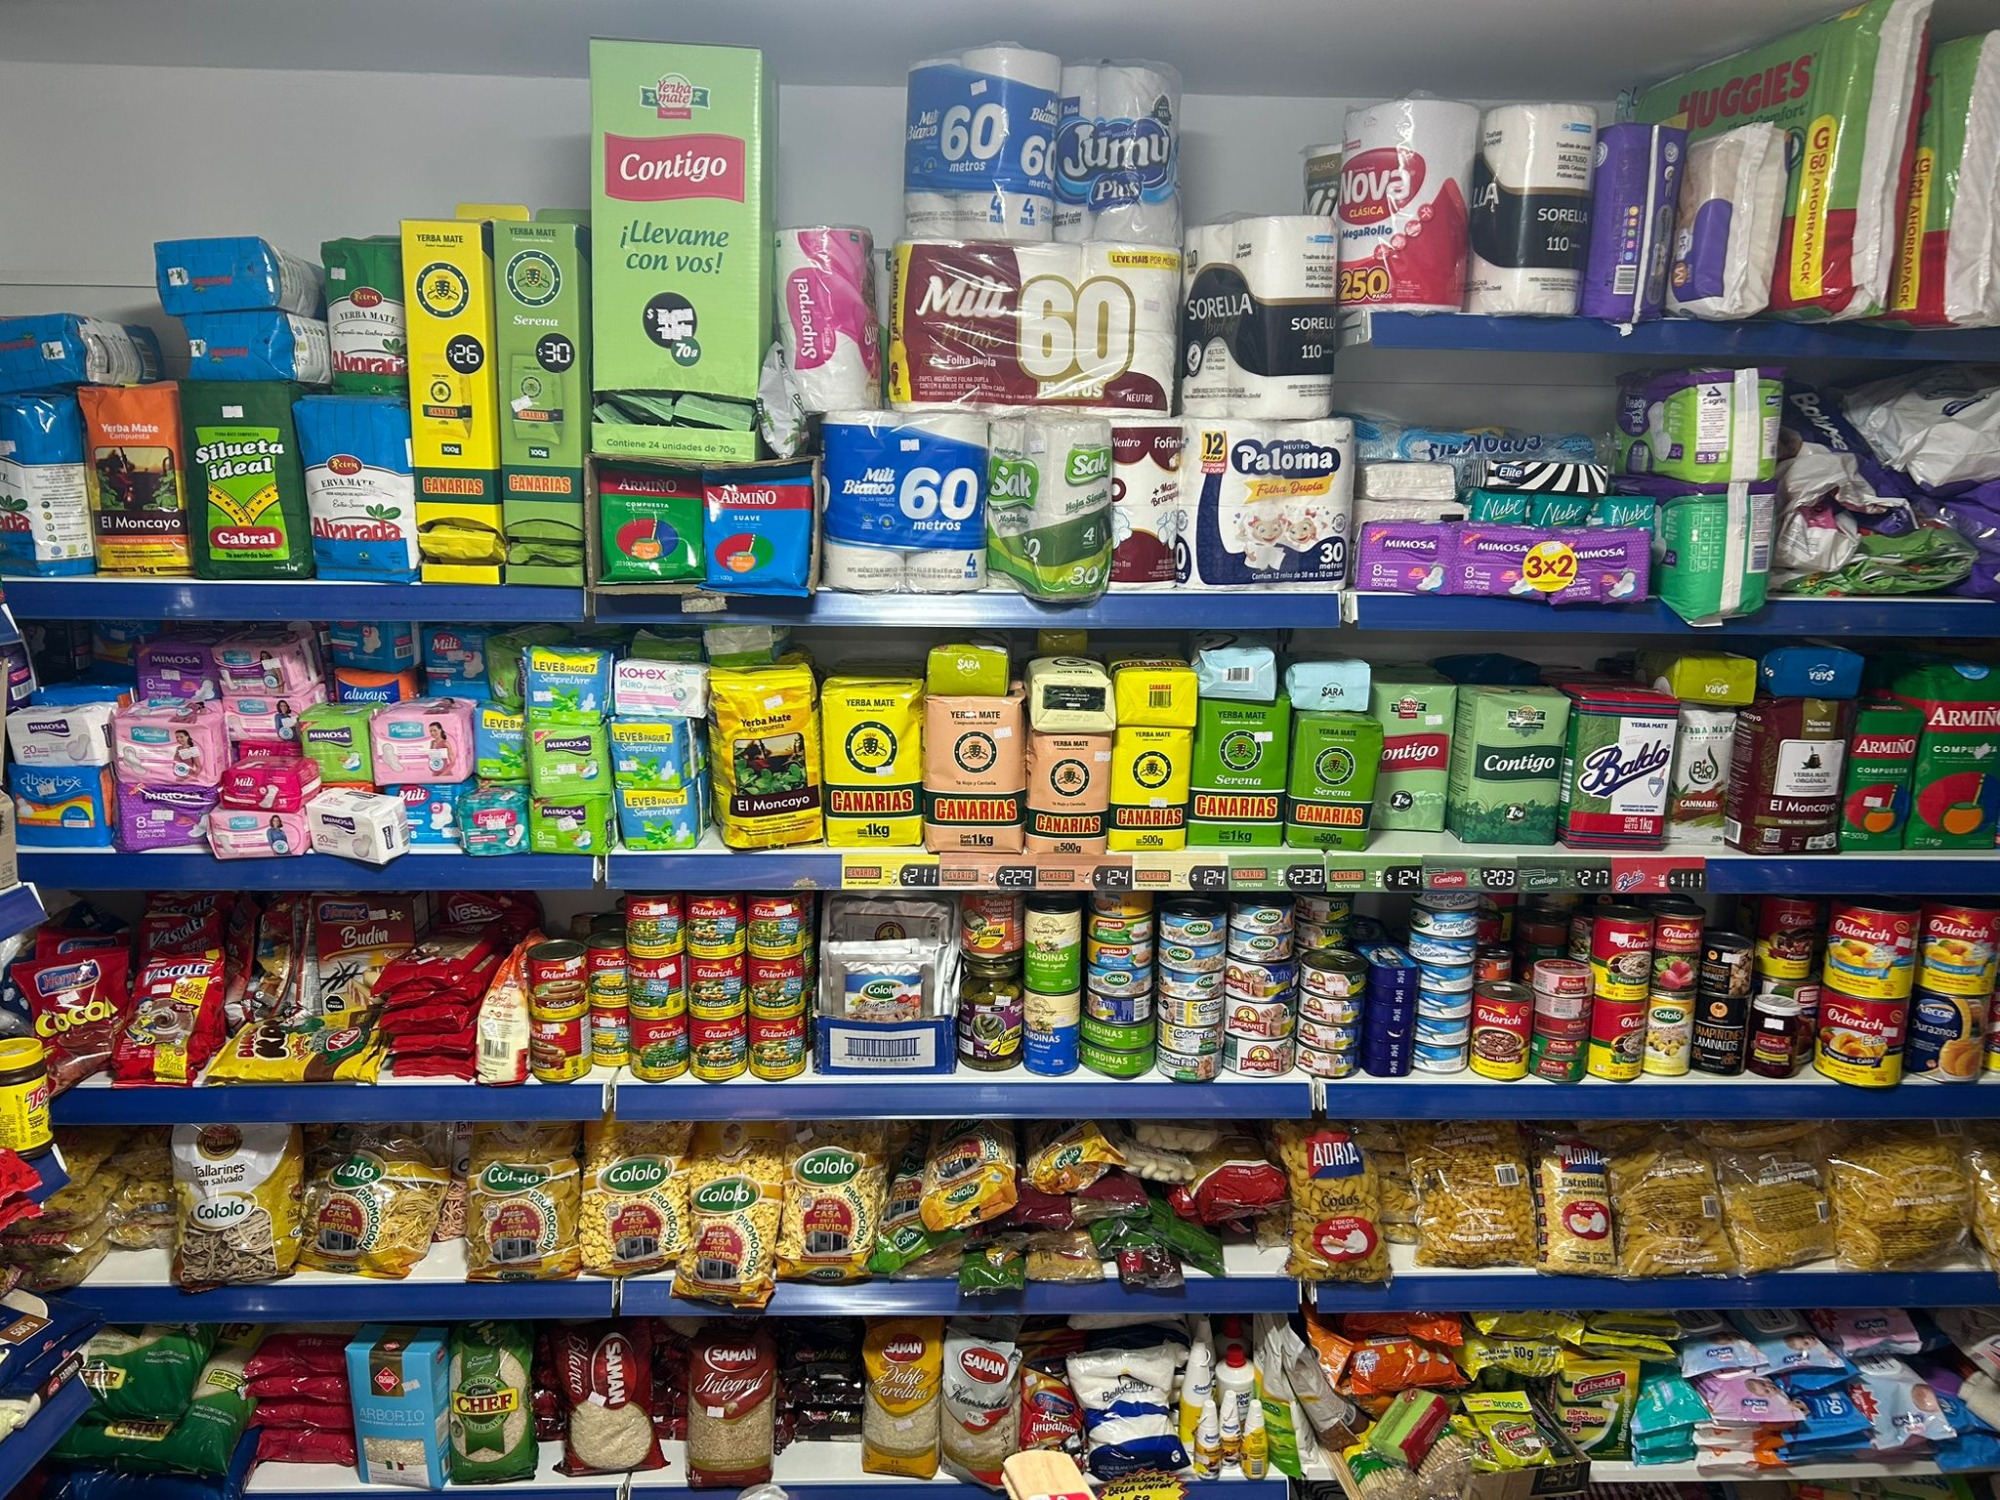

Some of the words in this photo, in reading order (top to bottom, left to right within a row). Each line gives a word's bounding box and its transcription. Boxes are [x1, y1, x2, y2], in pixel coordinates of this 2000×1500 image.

[657, 80, 692, 96] Yerba
[1679, 53, 1812, 131] HUGGIES
[659, 92, 690, 104] mate
[941, 102, 1008, 161] 60
[1814, 126, 1829, 150] G
[620, 150, 727, 182] Contigo
[950, 161, 985, 172] metros
[1558, 155, 1587, 163] MULTIUSO
[1099, 180, 1139, 199] Plus
[1340, 169, 1411, 206] Nova
[1350, 206, 1383, 218] CLÁSICA
[1538, 209, 1587, 223] SORELLA
[620, 220, 729, 249] ¡Llevame
[1342, 225, 1392, 239] MegaRollo
[1801, 178, 1820, 282] AHORRAPACK
[417, 234, 441, 242] YERBA
[443, 235, 463, 243] MATE
[1547, 237, 1569, 251] 110
[626, 252, 668, 270] con
[677, 252, 722, 274] vos!
[1112, 255, 1130, 263] LEVE
[1132, 256, 1148, 264] MAIS
[1150, 256, 1160, 264] POR
[1340, 267, 1389, 300] 250
[1188, 293, 1253, 321] SORELLA
[513, 315, 559, 326] Serena
[800, 277, 817, 358] Superpel
[676, 344, 698, 358] 70g
[1301, 345, 1321, 358] 110
[947, 355, 970, 365] Folha
[973, 356, 996, 367] Dupla
[1127, 393, 1152, 403] NEUTRO
[101, 423, 127, 434] Yerba
[131, 423, 158, 433] Mate
[196, 440, 285, 463] Silueta
[607, 439, 646, 448] Contiene
[648, 440, 660, 449] 24
[662, 442, 701, 452] unidades
[705, 444, 716, 452] de
[719, 445, 736, 454] 70g
[1204, 433, 1224, 455] 12
[1073, 454, 1107, 476] Sak
[1238, 447, 1333, 471] Paloma
[210, 458, 273, 480] ideal
[1499, 467, 1523, 478] Elite
[423, 477, 483, 495] CANARIAS
[618, 478, 677, 493] ARMIÑO
[842, 481, 895, 495] Bianco
[1257, 484, 1286, 496] Folha
[1290, 481, 1324, 494] Dupla
[900, 467, 978, 520] 60
[1541, 504, 1583, 525] Nube
[1612, 505, 1654, 522] Nube
[101, 516, 111, 528] El
[115, 516, 180, 529] Moncayo
[312, 517, 401, 541] Alvorada
[913, 520, 961, 531] metros
[218, 532, 276, 545] Cabral
[1384, 539, 1436, 550] MIMOSA
[1320, 542, 1343, 562] 30
[966, 553, 976, 570] 4
[1070, 567, 1098, 585] 30
[433, 639, 458, 650] Mili
[534, 661, 558, 671] LEVE
[559, 662, 565, 672] 8
[567, 664, 589, 673] PAGUE
[590, 664, 595, 673] 7
[957, 659, 980, 670] SARA
[619, 668, 666, 680] kotex
[344, 688, 389, 701] always
[1322, 686, 1344, 697] SARA
[846, 699, 871, 707] YERBA
[741, 718, 766, 728] Yerba
[769, 713, 791, 723] Mate
[1218, 710, 1244, 719] YERBA
[1246, 711, 1266, 720] MATE
[310, 731, 349, 739] MIMOSA
[23, 746, 36, 754] 20
[1858, 739, 1916, 754] ARMIÑO
[1484, 754, 1555, 772] Contigo
[234, 777, 254, 787] Mili
[1215, 774, 1262, 786] Serena
[738, 801, 748, 811] El
[754, 795, 810, 812] Moncayo
[832, 790, 913, 813] CANARIAS
[1680, 799, 1718, 808] CANNABIS
[1770, 800, 1782, 811] El
[1786, 800, 1836, 813] Moncayo
[543, 808, 584, 816] MIMOSA
[936, 799, 1017, 821] CANARIAS
[137, 818, 146, 828] 8
[866, 824, 890, 837] 1kg
[1036, 815, 1100, 833] CANARIAS
[972, 834, 994, 846] 1kg
[1060, 843, 1081, 852] 500g
[903, 869, 936, 884] $211
[1000, 869, 1032, 885] $229
[1289, 869, 1322, 884] $230
[1434, 875, 1462, 885] Contigo
[1483, 870, 1514, 885] $203
[1530, 877, 1559, 886] Contigo
[1577, 870, 1609, 885] $217
[1835, 919, 1890, 941] Oderich
[1930, 919, 1988, 938] Oderich
[341, 926, 389, 948] Budín
[1028, 952, 1069, 961] SARDINAS
[144, 964, 212, 985] VASCOLET
[545, 1000, 576, 1008] Salsichas
[35, 997, 118, 1037] COCOA
[1478, 1009, 1521, 1025] Oderich
[1654, 1010, 1681, 1021] Cololo
[1917, 1004, 1953, 1020] ARCOR
[1085, 1021, 1123, 1038] SARDINAS
[1912, 1019, 1957, 1038] Duraznos
[656, 1059, 679, 1067] Ervilha
[1242, 1060, 1278, 1071] EMIGRANTE
[1313, 1142, 1360, 1168] ADRIA
[194, 1162, 245, 1178] Tallarines
[803, 1157, 854, 1174] Cololo
[211, 1174, 243, 1186] salvado
[609, 1165, 662, 1183] Cololo
[1321, 1194, 1360, 1206] Codos
[198, 1204, 244, 1220] Cololo
[814, 1210, 840, 1219] CASA
[806, 1223, 849, 1232] SERVIDA
[1450, 1233, 1480, 1242] MOLINO
[1482, 1233, 1516, 1241] PURITAS
[712, 1348, 756, 1362] SAMAN
[1514, 1347, 1534, 1360] 60g
[567, 1332, 588, 1394] Blanco
[963, 1357, 1005, 1376] SAMAN
[605, 1342, 625, 1404] SAMAN
[883, 1366, 924, 1385] Doble
[696, 1370, 768, 1399] Integral
[872, 1379, 928, 1399] Carolina
[1577, 1375, 1621, 1392] Griselda
[456, 1394, 513, 1412] CHEF
[1493, 1398, 1524, 1410] bronce
[359, 1408, 424, 1420] ARBORIO
[1566, 1415, 1604, 1423] esponja
